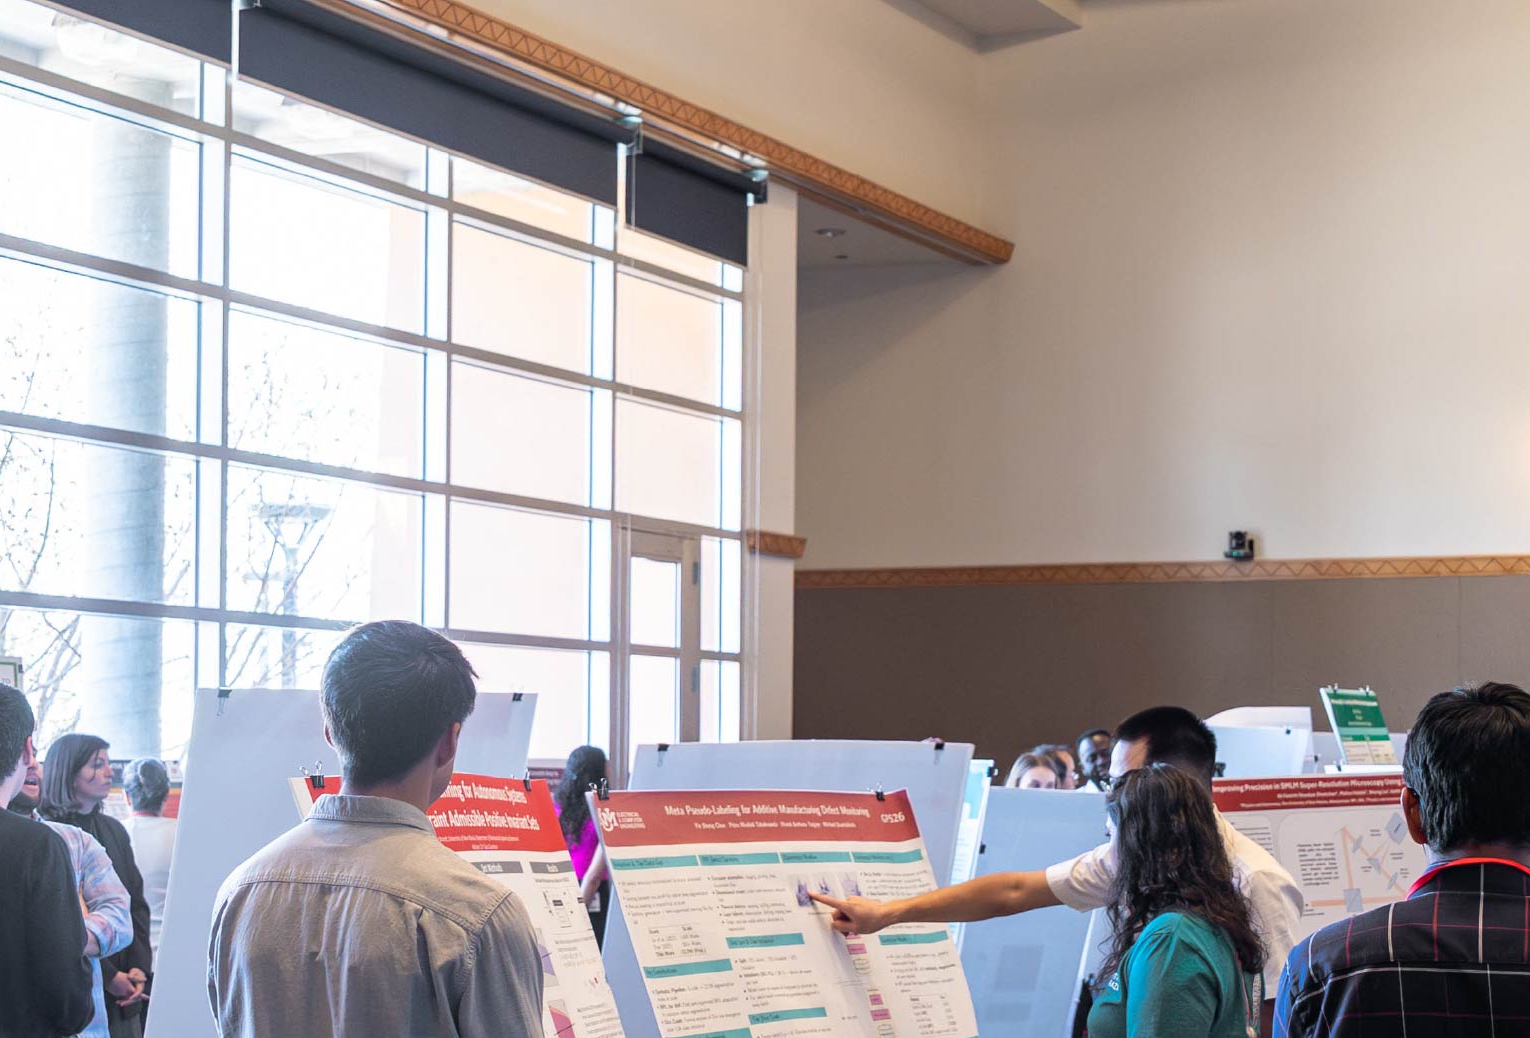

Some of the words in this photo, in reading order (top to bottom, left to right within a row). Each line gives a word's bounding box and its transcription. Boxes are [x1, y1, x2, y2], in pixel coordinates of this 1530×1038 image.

[472, 783, 507, 801] Autonomous
[1244, 782, 1273, 792] Precision
[1349, 778, 1384, 789] Microscopy
[448, 809, 486, 827] Admissible
[484, 811, 507, 829] Positive
[664, 804, 685, 816] Meta
[685, 804, 740, 817] Pseudo-Labeling
[741, 804, 751, 814] for
[752, 804, 778, 815] Additive
[779, 804, 821, 817] Manufacturing
[821, 805, 839, 815] Defect
[839, 806, 870, 818] Monitoring
